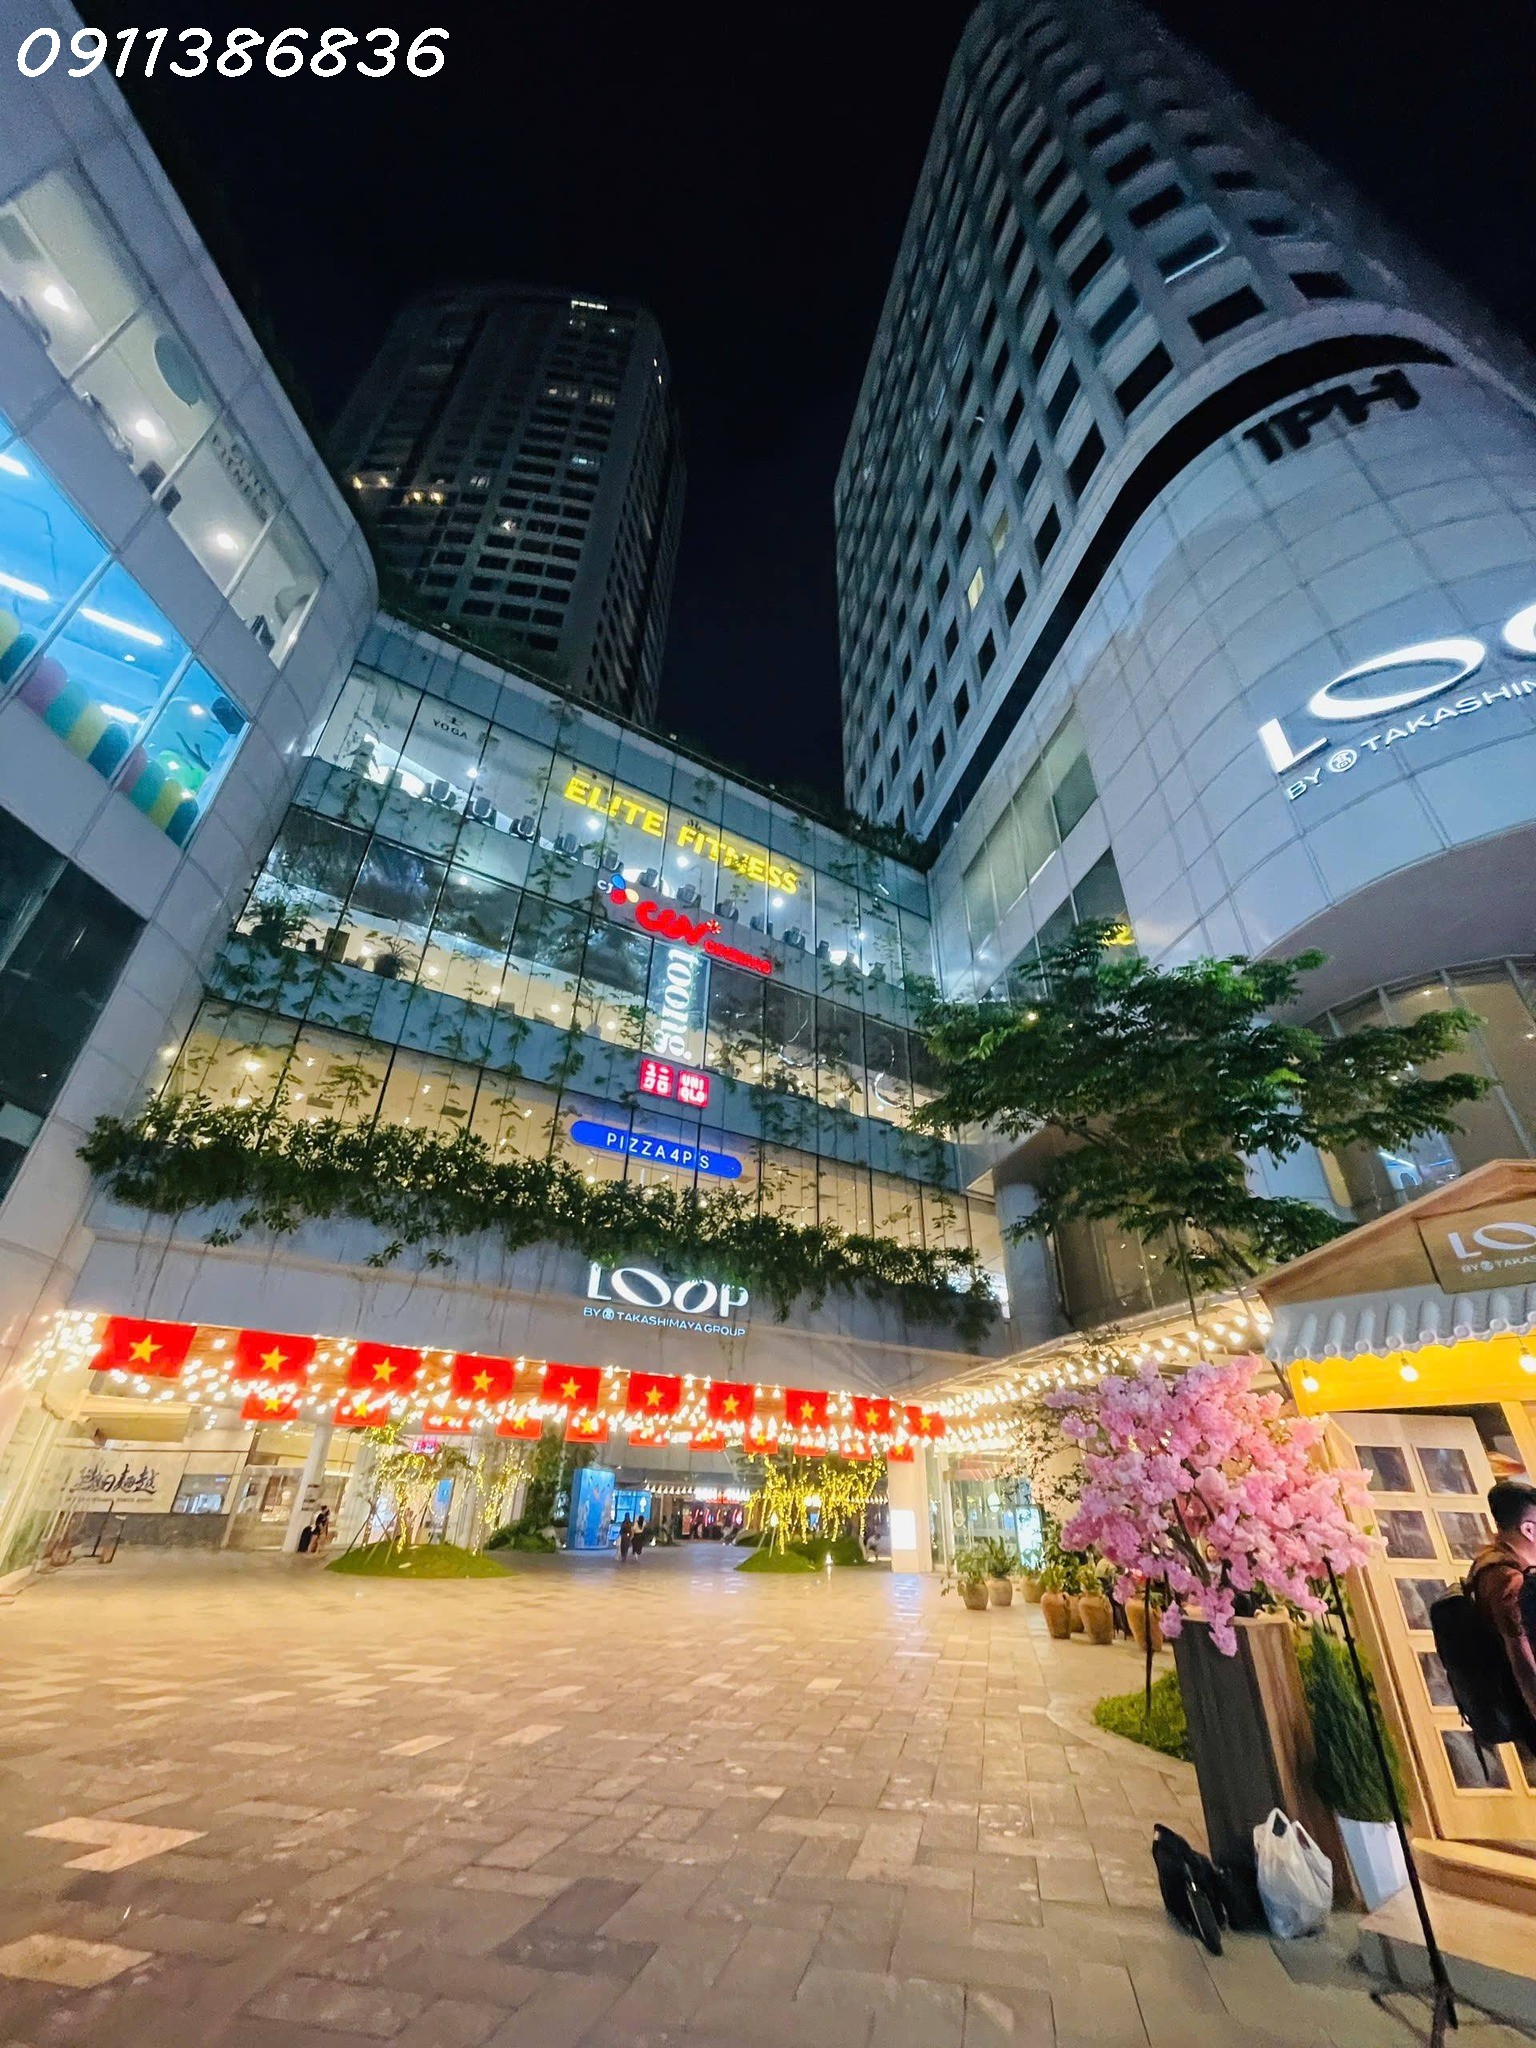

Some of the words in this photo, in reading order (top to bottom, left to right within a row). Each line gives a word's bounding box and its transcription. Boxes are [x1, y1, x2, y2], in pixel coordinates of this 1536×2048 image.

[1287, 767, 1321, 800] BY
[564, 777, 665, 837] ELITE
[677, 825, 798, 895] FITNESS
[597, 880, 613, 893] CJ
[654, 949, 699, 1060] toong
[587, 1262, 749, 1318] LOOP
[583, 1307, 600, 1317] BY
[617, 1311, 701, 1331] TAKASHIMAYA
[704, 1323, 746, 1337] GROUP
